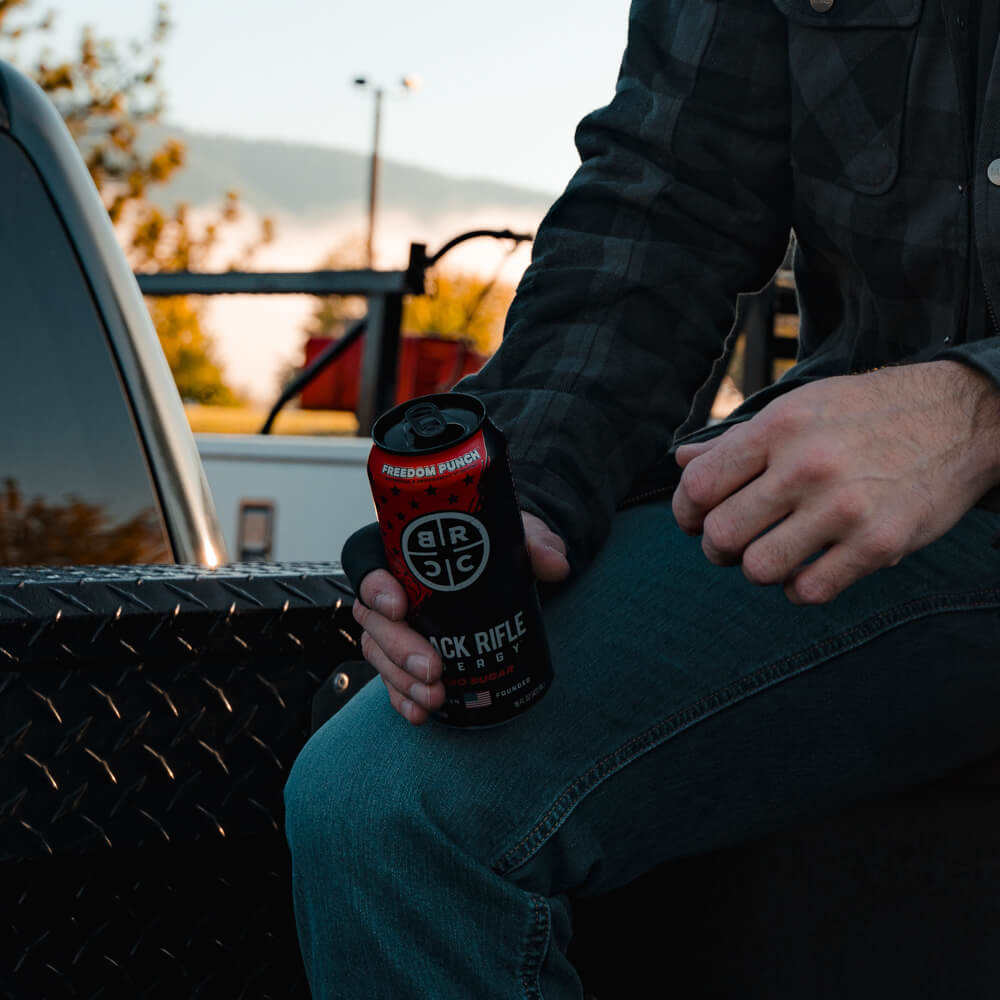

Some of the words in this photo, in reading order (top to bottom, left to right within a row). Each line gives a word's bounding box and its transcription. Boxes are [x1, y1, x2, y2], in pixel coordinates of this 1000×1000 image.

[381, 463, 437, 478] FREEDOM
[437, 448, 481, 474] PUNCH
[428, 634, 471, 659] ACK
[473, 610, 528, 655] RIFLE
[444, 642, 520, 672] ERGY
